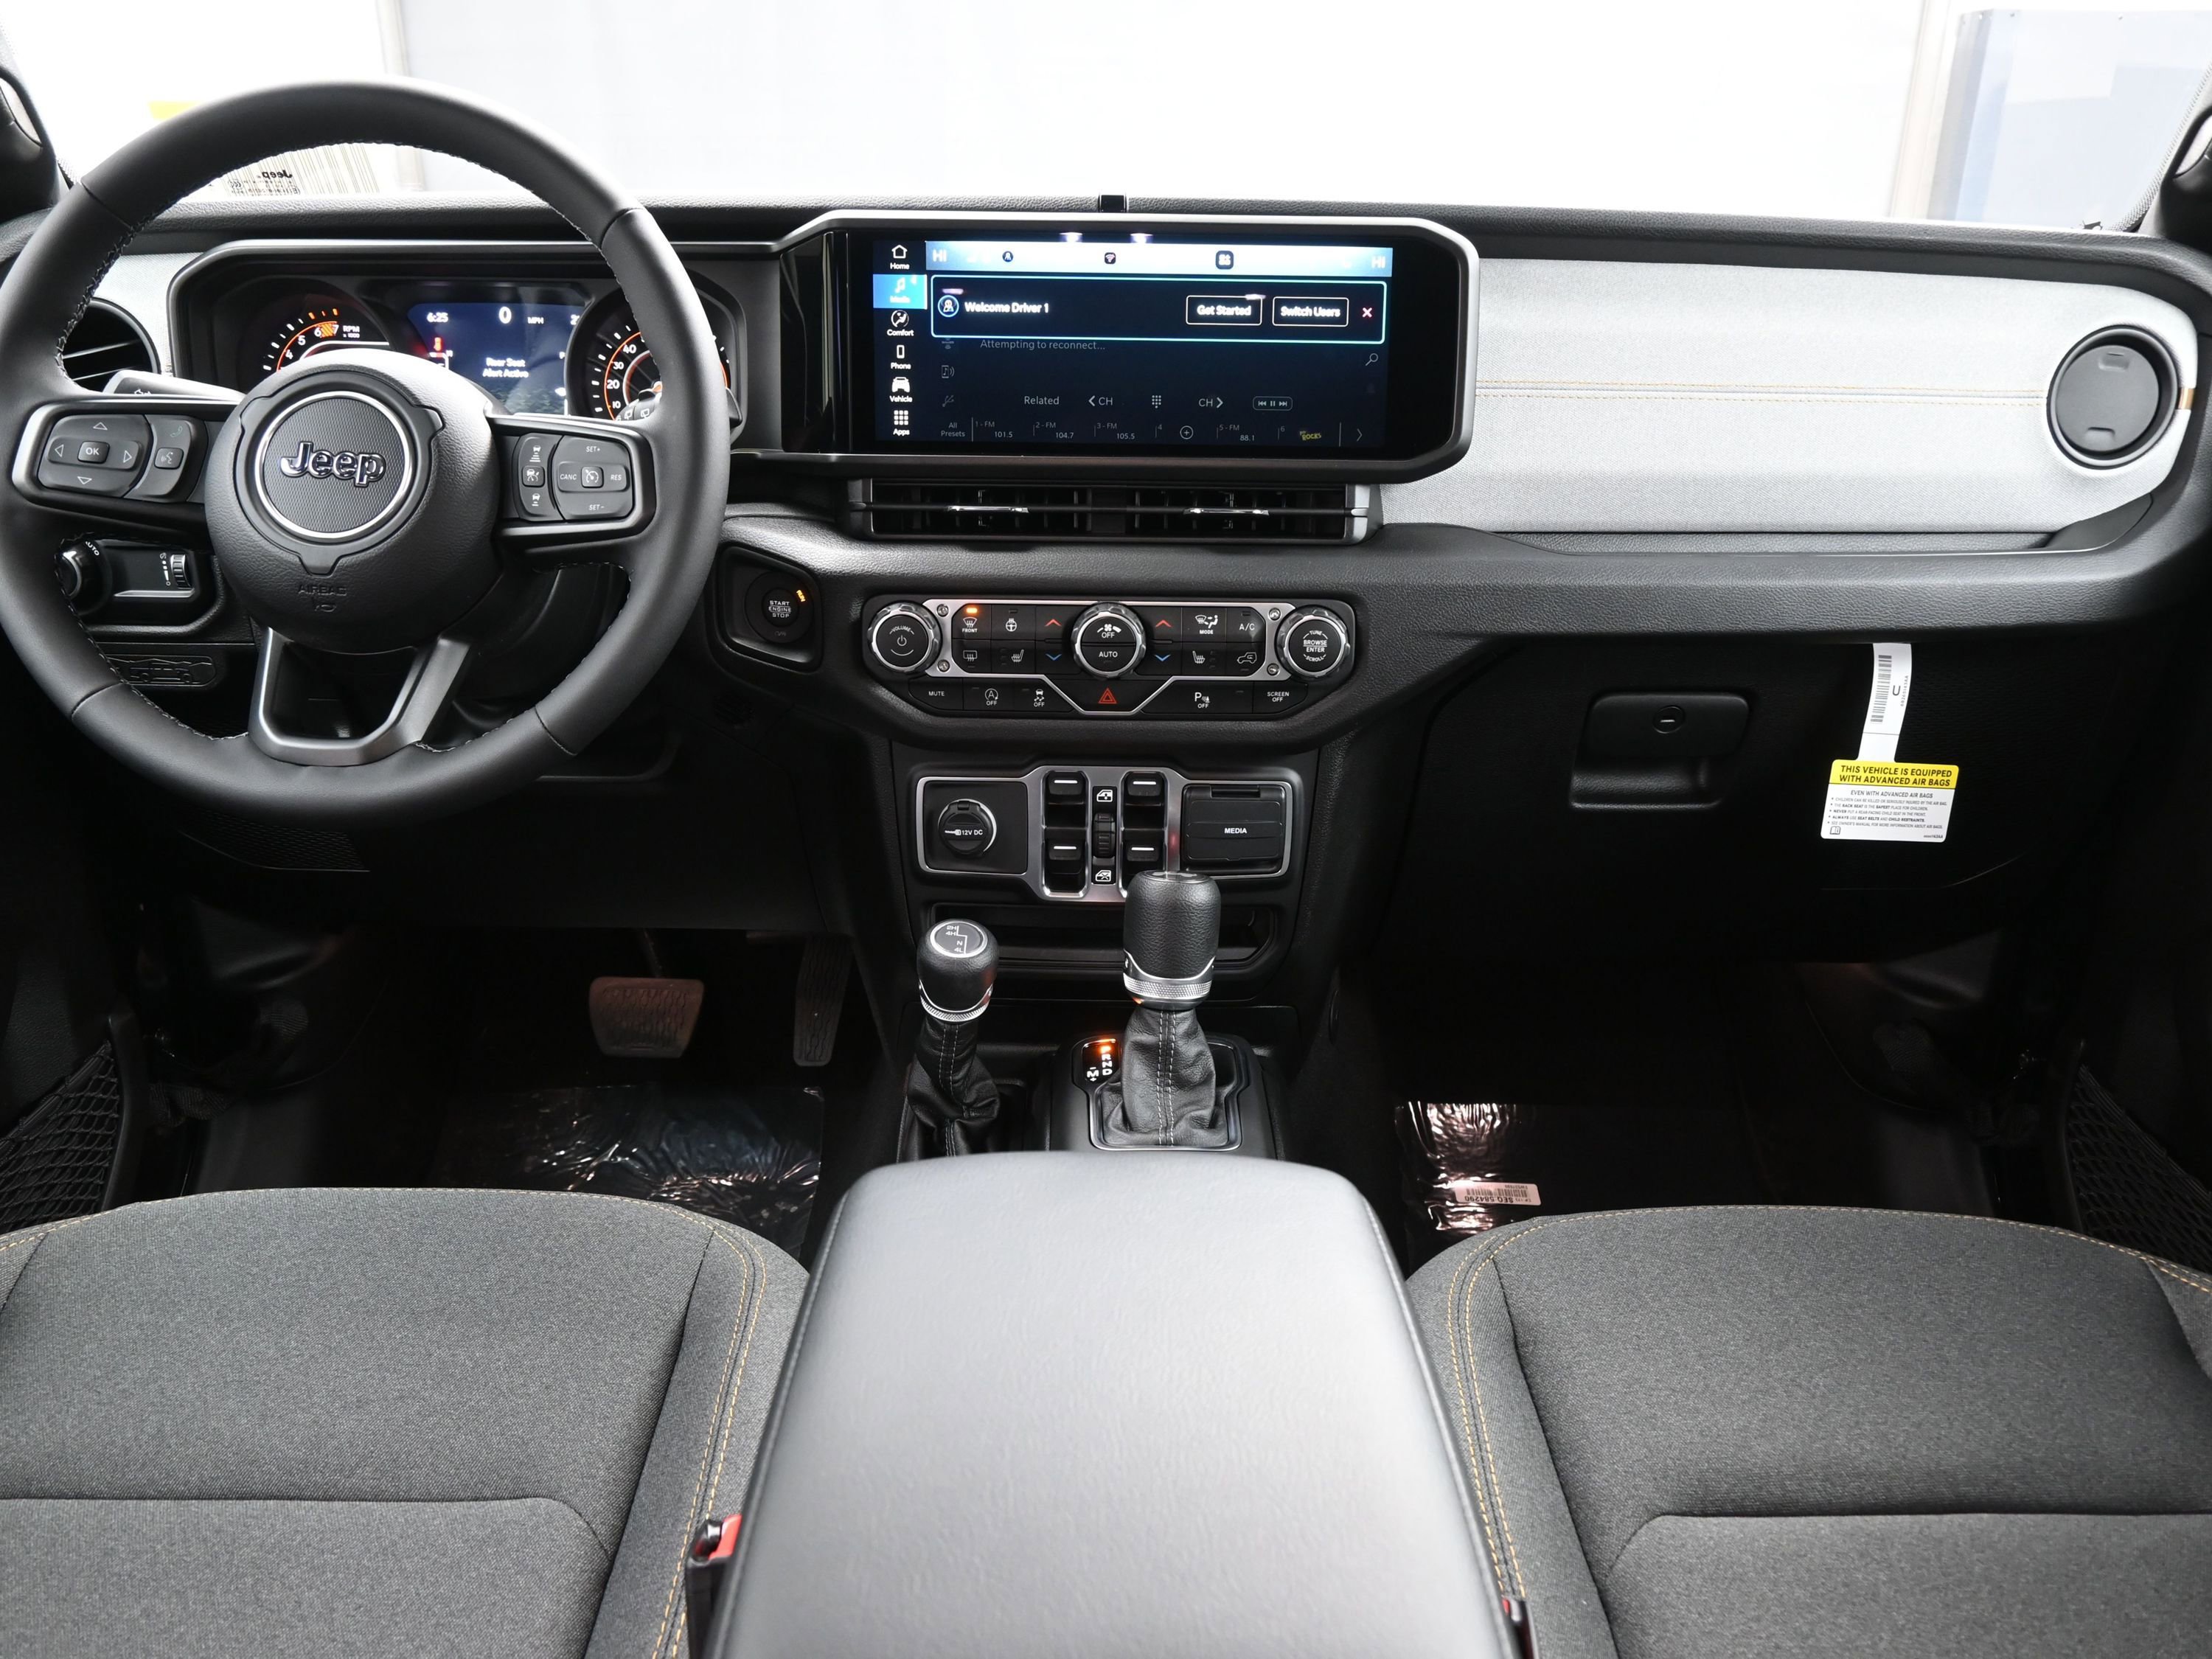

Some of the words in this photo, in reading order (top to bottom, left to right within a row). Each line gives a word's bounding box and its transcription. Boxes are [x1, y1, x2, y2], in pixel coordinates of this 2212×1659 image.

[964, 302, 1010, 313] Welcome
[1012, 302, 1042, 313] Driver
[1043, 303, 1049, 313] 1
[1197, 305, 1214, 316] Get
[1216, 305, 1251, 316] Started
[1281, 307, 1312, 317] Switch
[1314, 307, 1340, 318] Users
[426, 312, 448, 323] 6:25
[498, 306, 512, 324] 0
[314, 327, 321, 337] 6
[333, 324, 339, 334] 7
[298, 335, 306, 346] 5
[980, 339, 1034, 350] Attempting
[1037, 341, 1046, 349] to
[623, 344, 637, 354] 40
[285, 349, 293, 360] 4
[613, 361, 625, 370] 30
[607, 380, 619, 389] 20
[612, 400, 621, 408] 10
[889, 395, 912, 403] Vehicle
[1024, 396, 1060, 406] Related
[1098, 397, 1113, 406] CH
[1199, 399, 1214, 407] CH
[893, 428, 911, 437] Apps
[86, 447, 100, 456] OK
[280, 441, 386, 487] Jeep
[1892, 685, 1901, 696] U
[1841, 765, 1860, 773] THIS
[1863, 766, 1899, 775] VEHICLE
[1910, 769, 1952, 777] EQUIPPED
[1864, 776, 1910, 785] ADVANCED
[1928, 779, 1951, 787] BAGS
[1087, 1070, 1099, 1078] M
